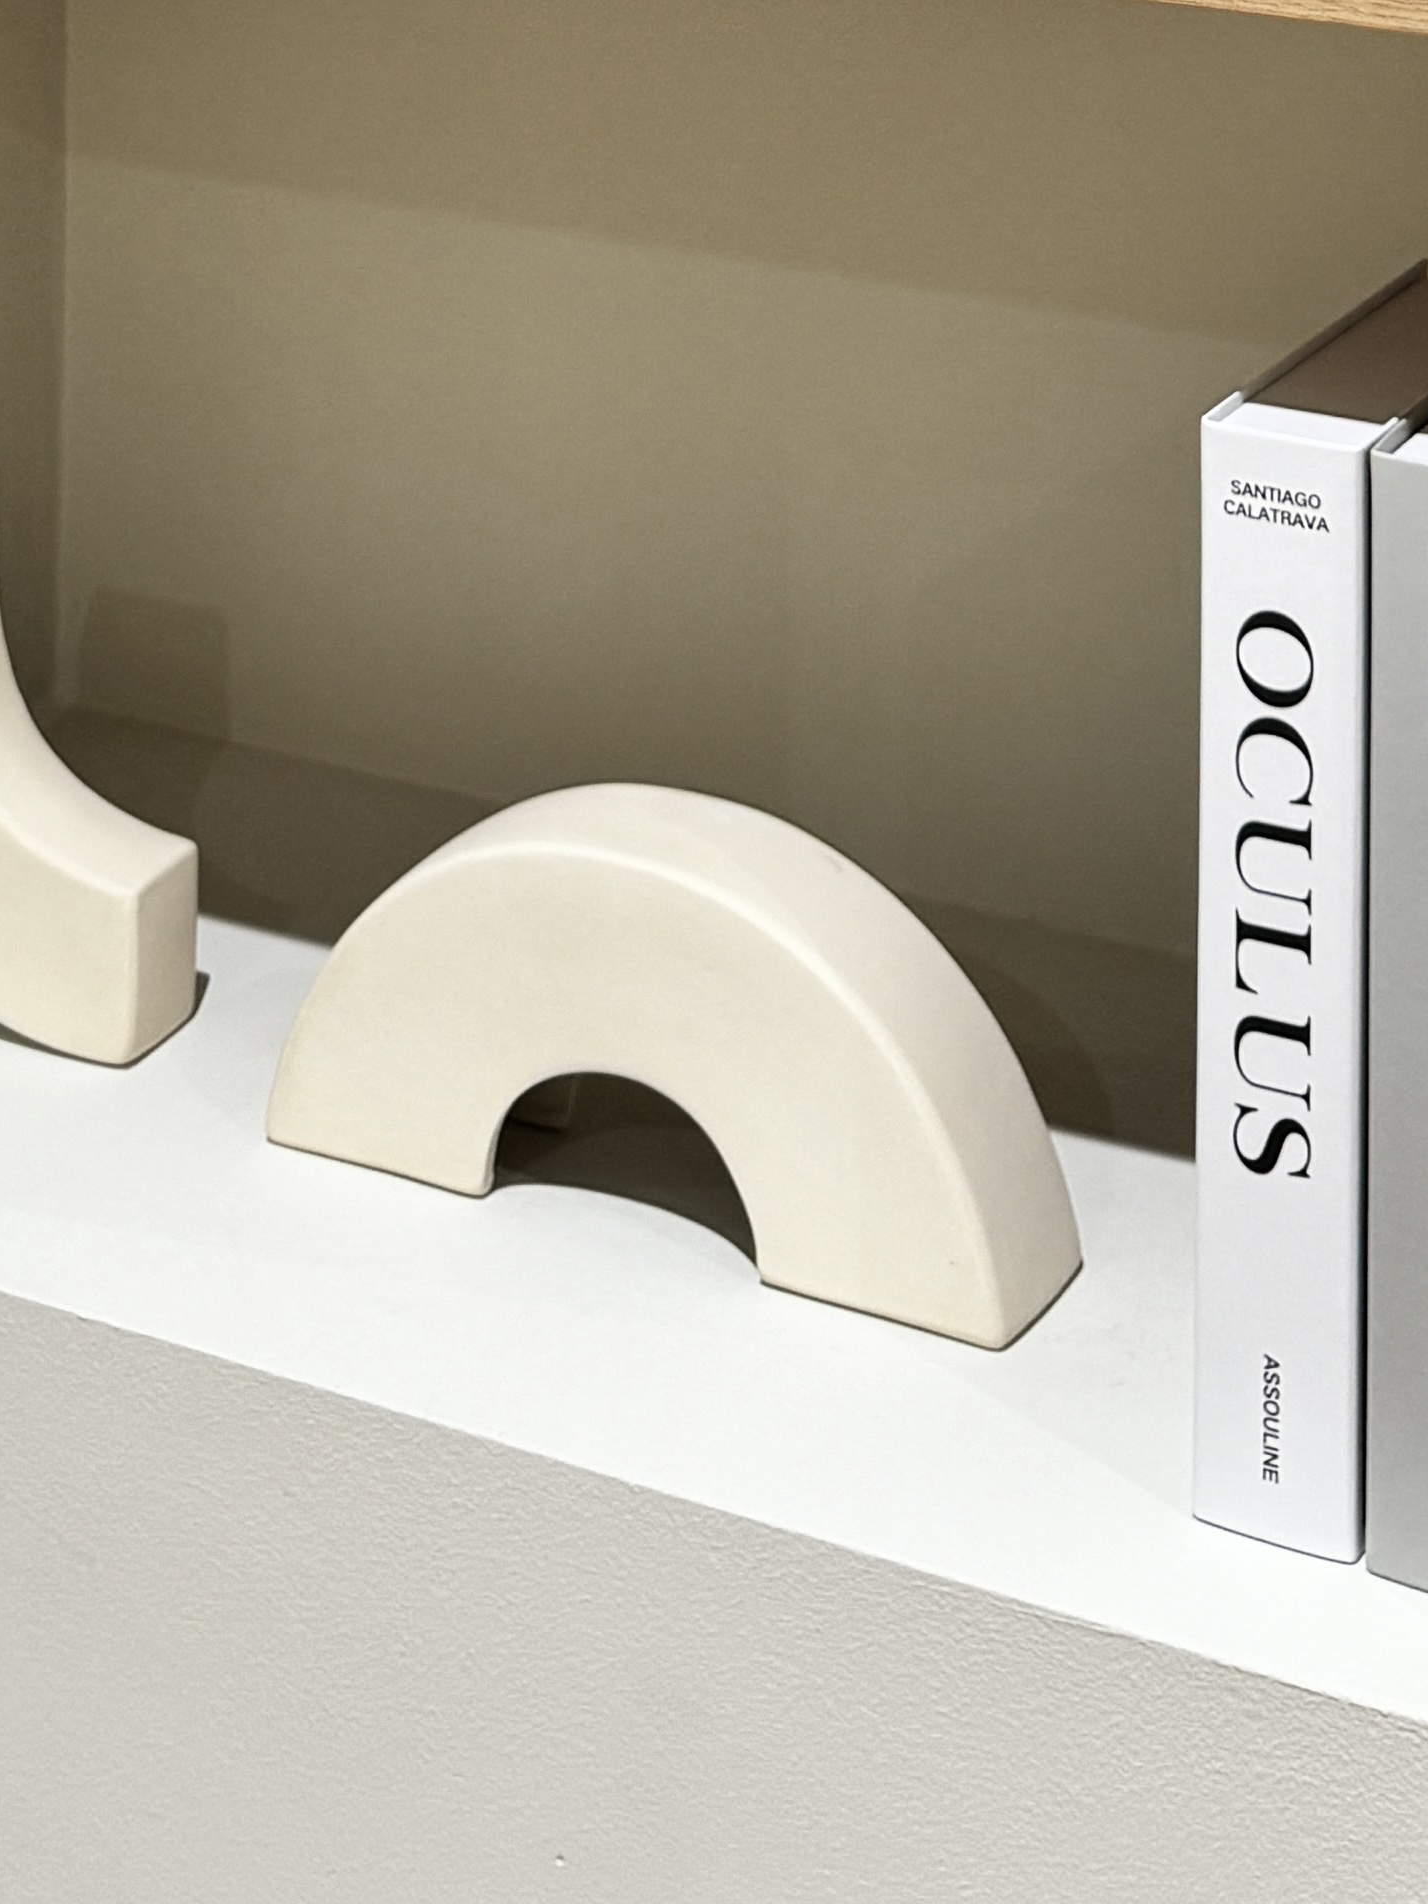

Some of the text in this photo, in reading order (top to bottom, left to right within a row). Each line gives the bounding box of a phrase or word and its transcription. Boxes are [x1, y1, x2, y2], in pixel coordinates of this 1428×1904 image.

[1223, 499, 1330, 533] CALATRAVA
[1230, 479, 1322, 510] SANTIAGO
[1233, 609, 1314, 1179] OCULUS
[1262, 1353, 1281, 1484] ASSOULINE
